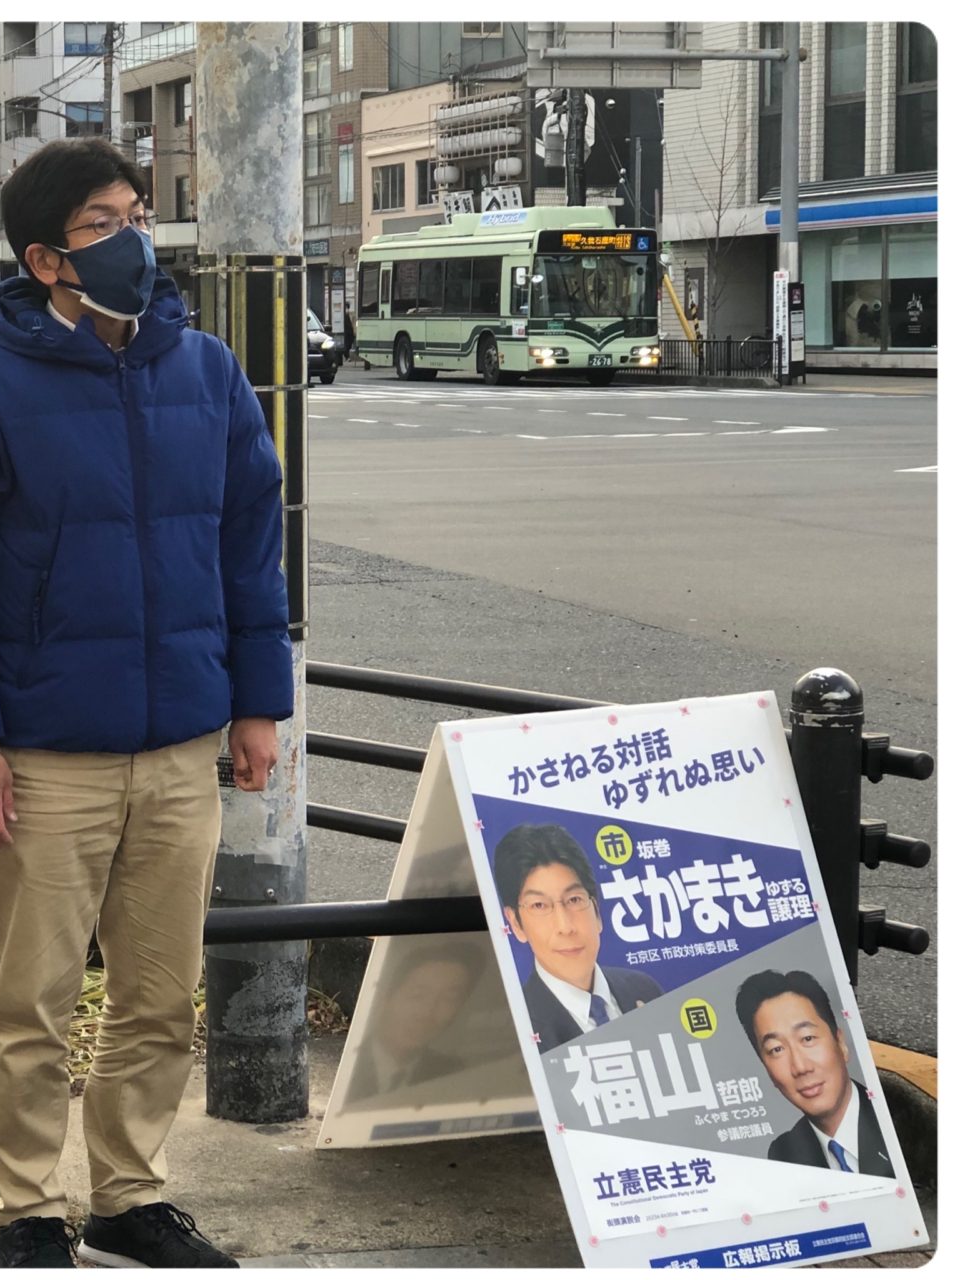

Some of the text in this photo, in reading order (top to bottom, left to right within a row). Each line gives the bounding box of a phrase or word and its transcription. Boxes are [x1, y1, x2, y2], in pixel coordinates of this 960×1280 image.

[508, 728, 673, 796] かさねる対話
[603, 746, 766, 810] ゆずれぬ思い
[600, 832, 672, 860] 市 坂巻
[600, 853, 770, 943] さかまき
[625, 938, 740, 965] 右京区 市政対策委員長
[685, 1005, 713, 1033] 国
[563, 1032, 720, 1127] 福山
[715, 1076, 764, 1106] 哲郎
[694, 1105, 768, 1126] ふくやま てつろう
[717, 1122, 775, 1143] 参議院議員
[593, 1157, 716, 1200] 立憲民主党
[722, 1238, 803, 1268] 広報掲示板
